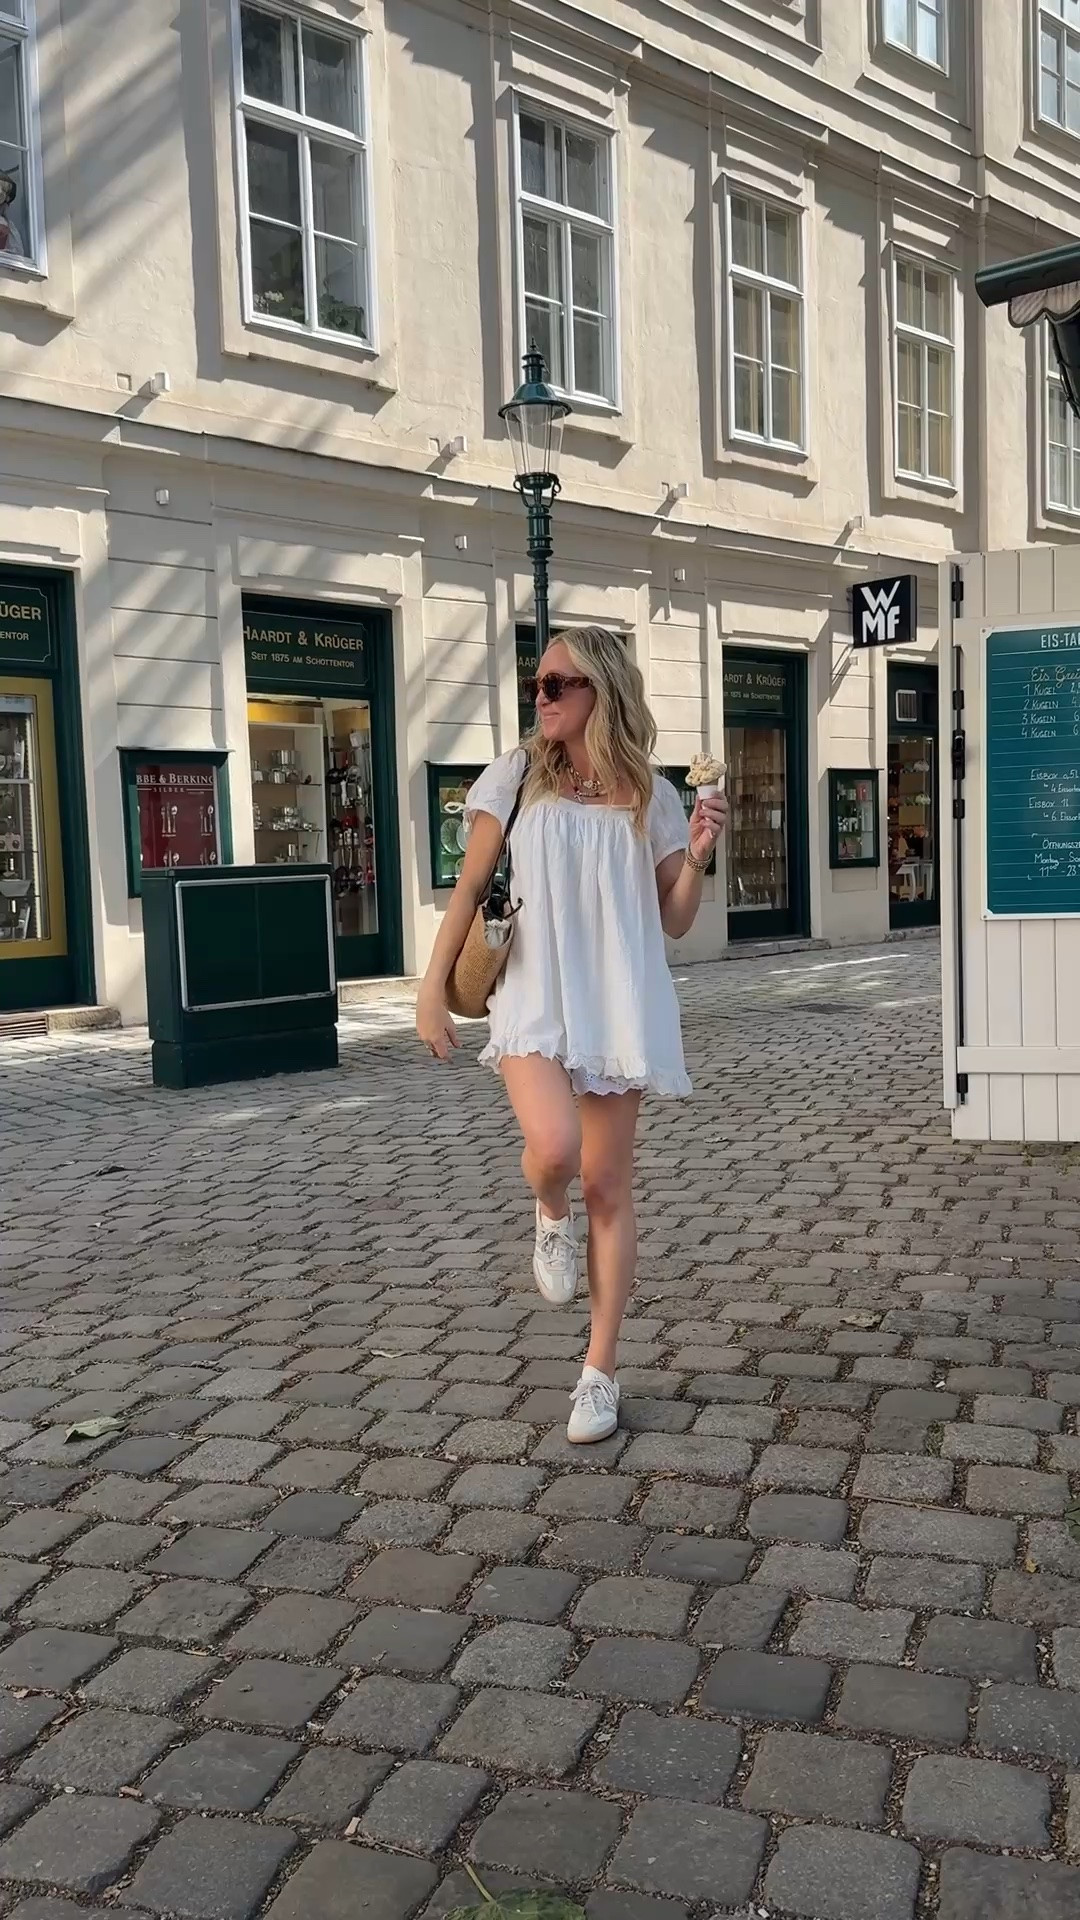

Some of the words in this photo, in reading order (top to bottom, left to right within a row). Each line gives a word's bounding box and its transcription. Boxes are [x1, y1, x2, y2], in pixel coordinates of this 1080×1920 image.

[860, 580, 901, 643] WMF
[243, 625, 292, 644] HAARDT
[298, 631, 308, 646] &
[314, 633, 364, 651] KRÜGER
[251, 651, 268, 661] SEIT
[271, 653, 290, 663] 1875
[306, 656, 355, 669] SCHOTTENTOR
[746, 673, 752, 684] &
[756, 674, 786, 687] KRÜGER
[1031, 667, 1050, 682] Eis
[1023, 684, 1030, 696] 1
[1023, 699, 1030, 711] 2
[1022, 713, 1029, 725] 3
[1021, 728, 1028, 739] 4
[159, 774, 167, 784] &
[1051, 784, 1056, 793] 4
[1051, 811, 1057, 821] 6
